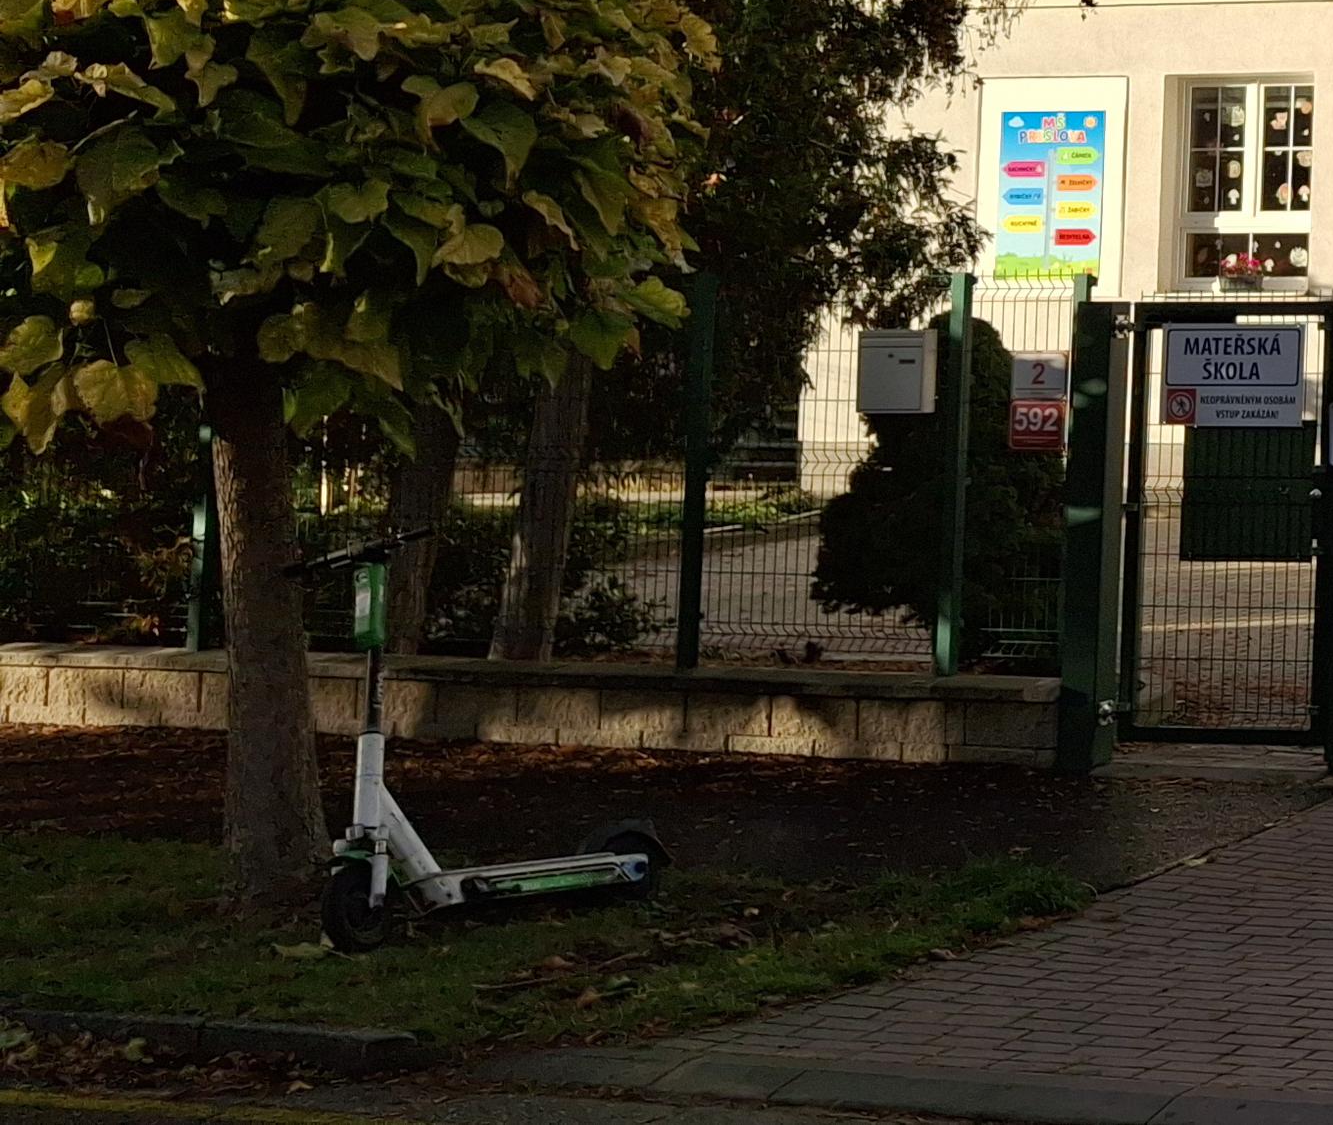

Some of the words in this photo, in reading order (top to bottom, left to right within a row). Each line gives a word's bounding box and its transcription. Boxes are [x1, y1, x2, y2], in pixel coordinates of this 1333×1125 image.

[1184, 333, 1281, 356] MATEŘSKÁ
[1031, 362, 1046, 385] 2
[1202, 358, 1260, 380] ŠKOLA
[1200, 394, 1262, 405] NEOPRÁVNĚNÝM
[1263, 394, 1296, 405] OSOBÁM
[1013, 407, 1059, 432] 592
[1215, 409, 1239, 419] VSTUP
